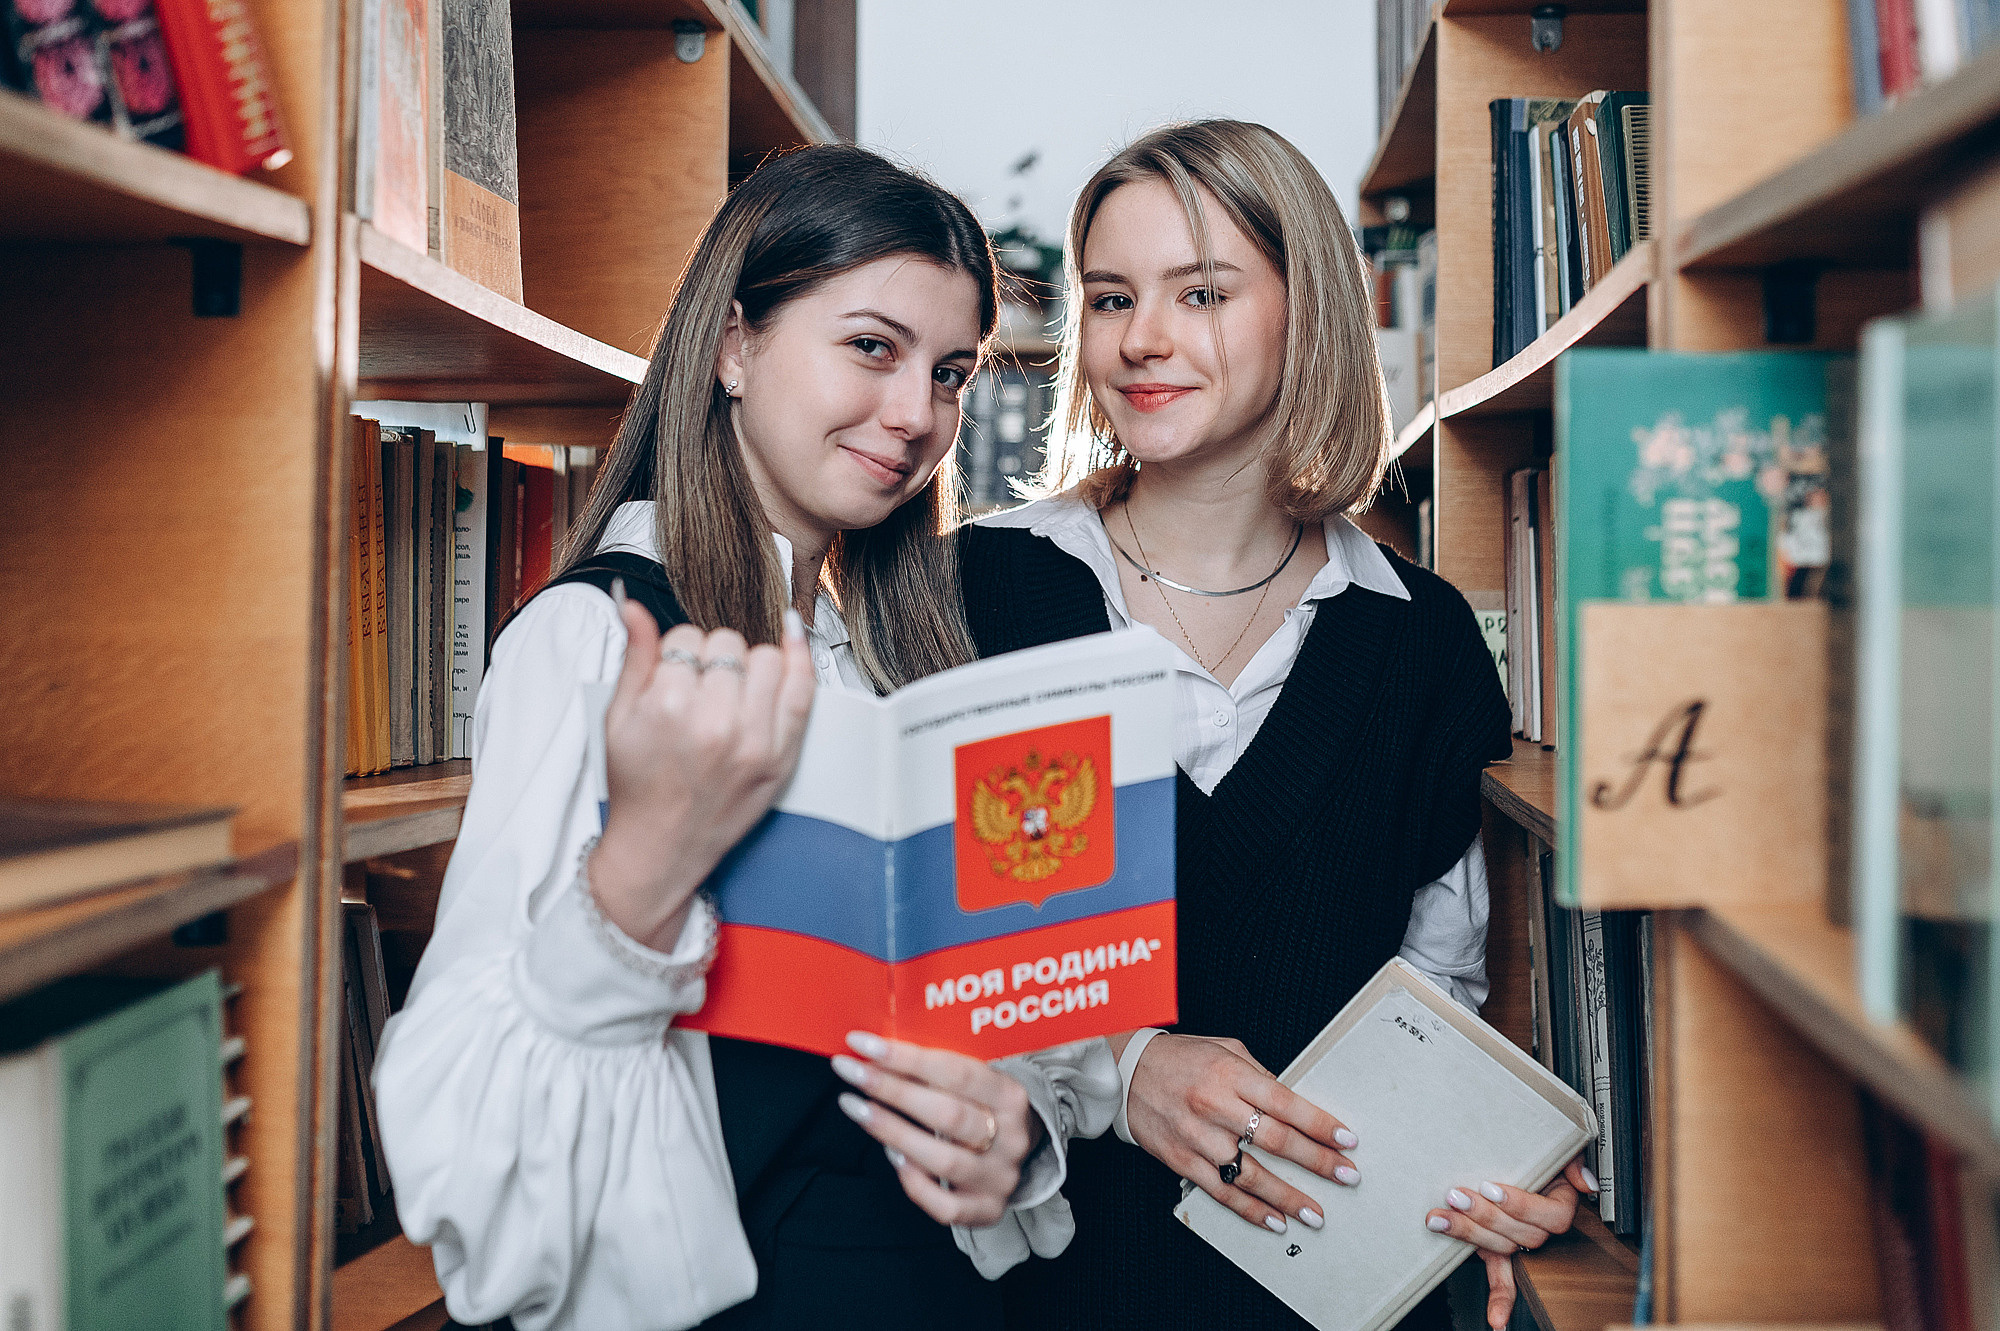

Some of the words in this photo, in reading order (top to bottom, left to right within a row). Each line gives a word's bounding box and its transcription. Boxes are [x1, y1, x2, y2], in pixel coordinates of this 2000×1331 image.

[1587, 698, 1727, 811] А
[925, 968, 1005, 1010] МОЯ
[1011, 937, 1162, 991] РОДИНА-
[970, 979, 1110, 1035] РОССИЯ
